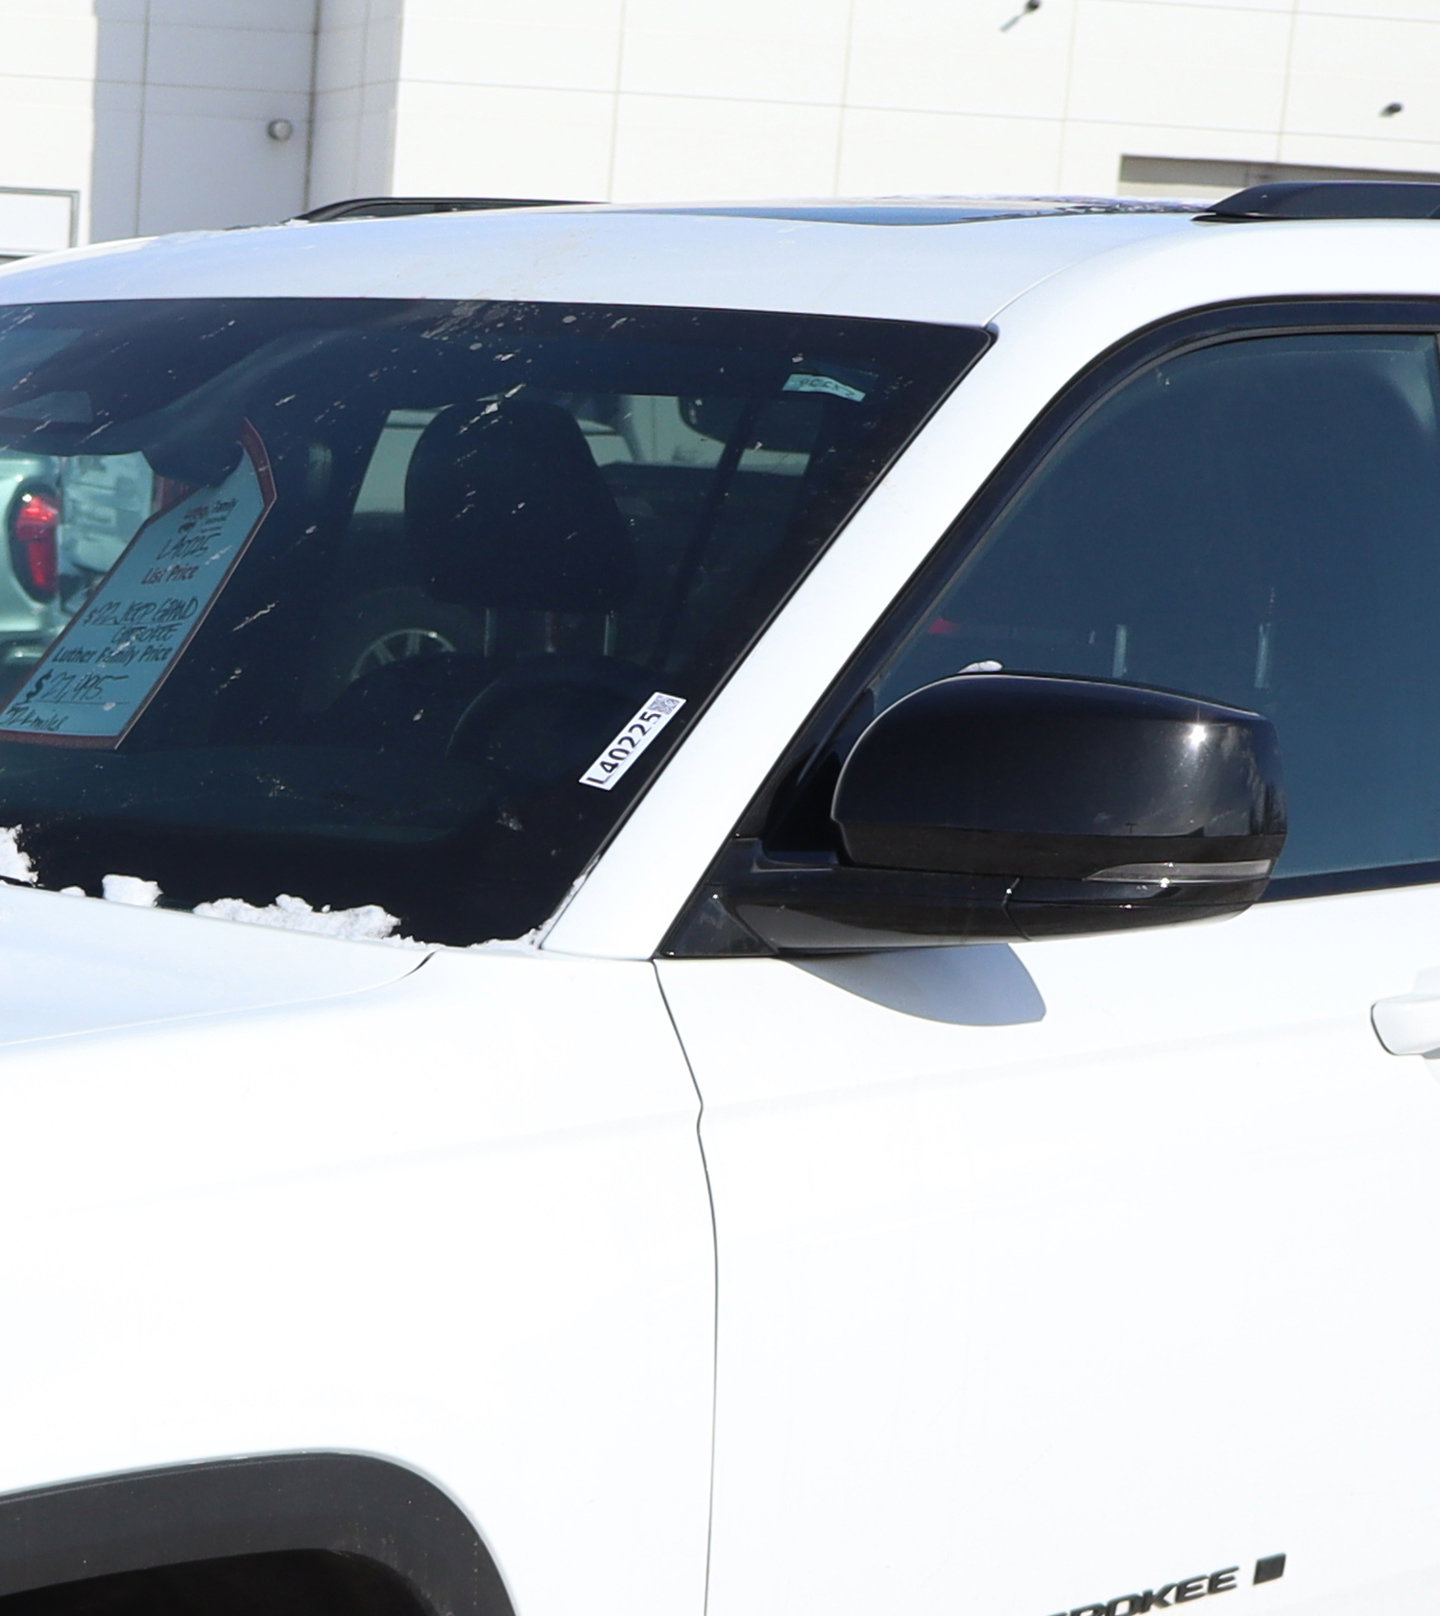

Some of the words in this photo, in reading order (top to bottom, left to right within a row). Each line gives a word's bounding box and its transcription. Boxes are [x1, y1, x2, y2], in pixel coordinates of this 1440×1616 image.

[141, 566, 166, 585] List
[165, 564, 200, 584] Price
[52, 647, 96, 664] Luther
[94, 646, 140, 668] Family
[138, 645, 173, 664] Price
[586, 711, 662, 785] L40225
